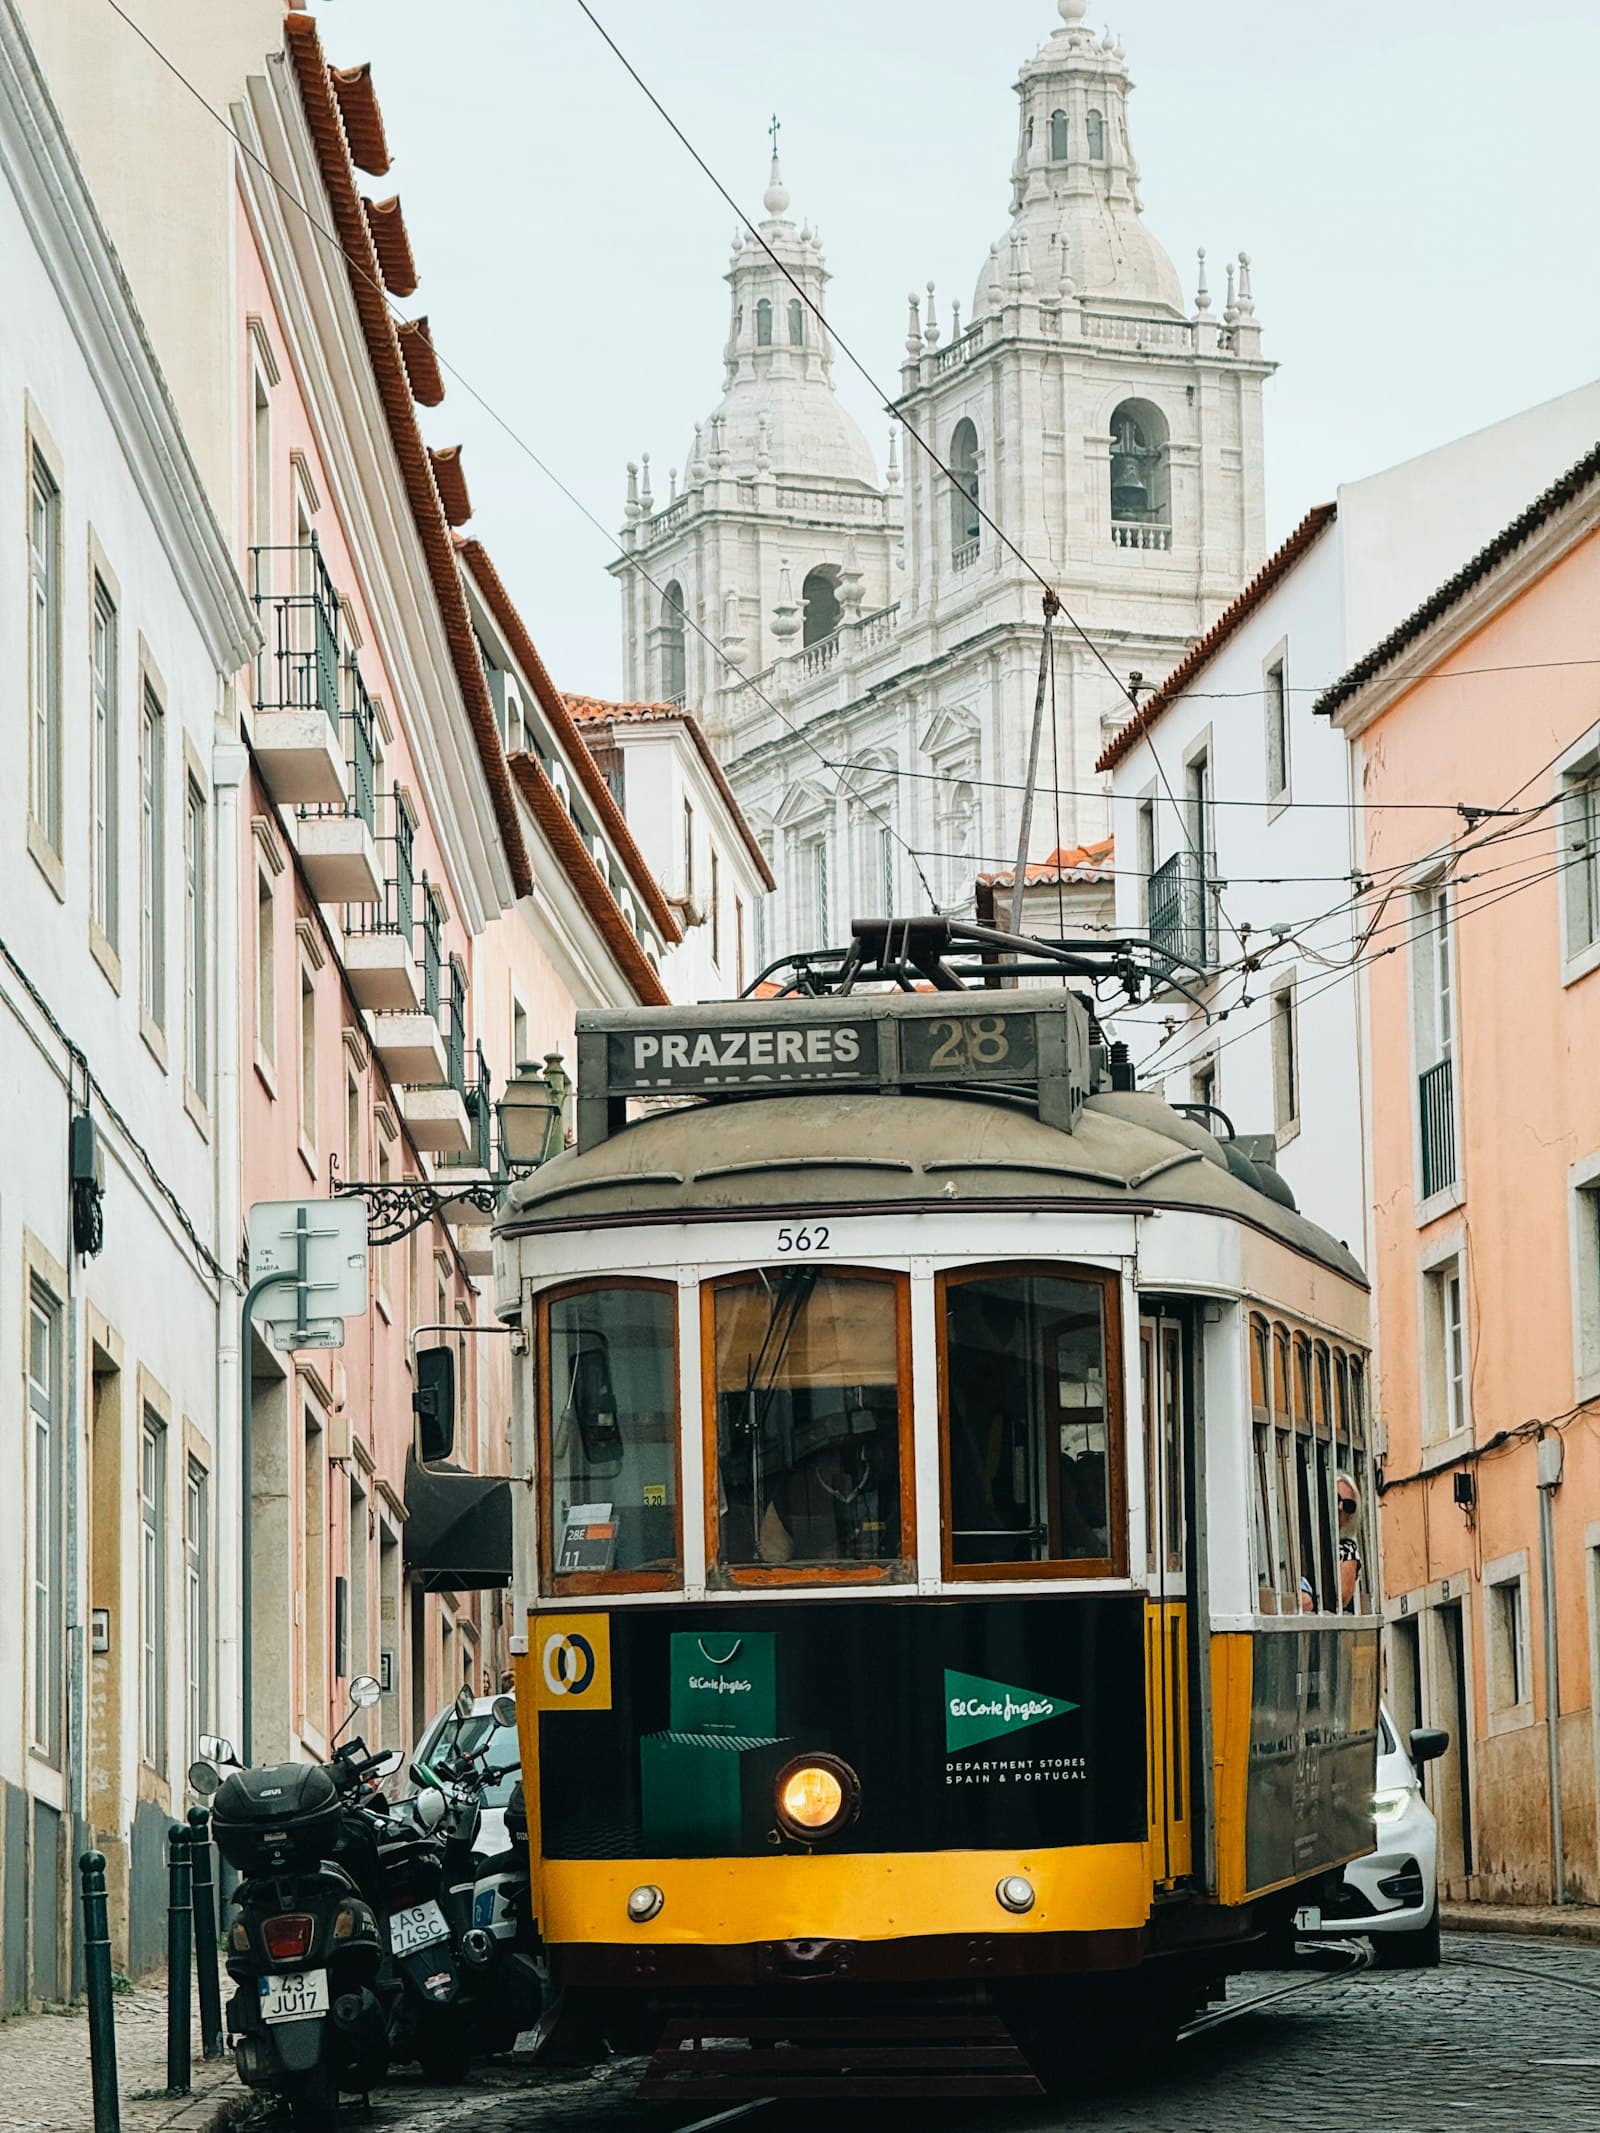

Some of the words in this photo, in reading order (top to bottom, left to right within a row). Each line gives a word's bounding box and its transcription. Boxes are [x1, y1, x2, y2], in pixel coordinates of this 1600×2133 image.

[633, 1028, 860, 1069] PRAZERES
[927, 1016, 1009, 1068] 28
[777, 1226, 830, 1252] 562
[567, 1529, 586, 1541] 28E
[564, 1550, 580, 1568] 11
[950, 1698, 967, 1716] El
[967, 1699, 1003, 1716] Corte
[1003, 1693, 1054, 1721] Inglés
[946, 1760, 1034, 1771] DEPARTMENT
[1039, 1757, 1086, 1768] STORES
[946, 1774, 990, 1785] SPAIN
[998, 1773, 1006, 1783] &
[1015, 1770, 1087, 1782] PORTUGAL
[400, 1908, 425, 1930] AG
[393, 1920, 442, 1949] 74SC
[282, 1975, 305, 1993] 43
[272, 1991, 317, 2014] JU17
